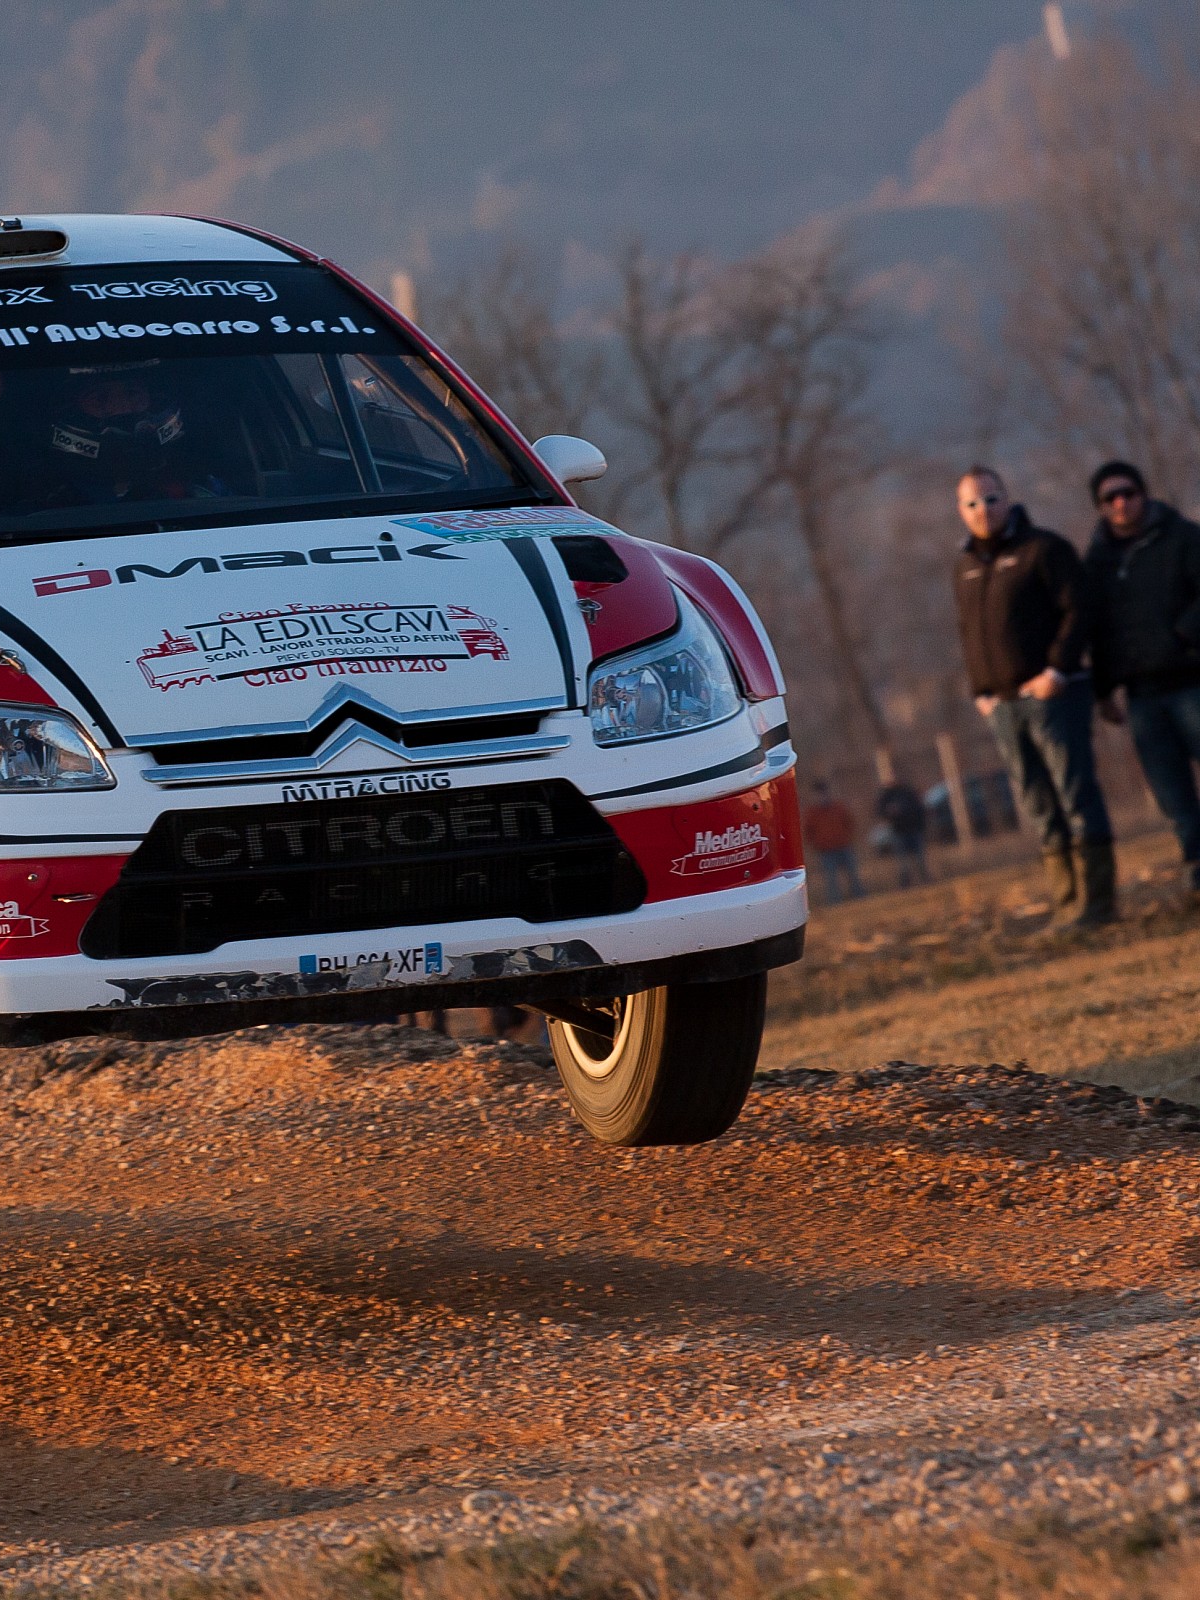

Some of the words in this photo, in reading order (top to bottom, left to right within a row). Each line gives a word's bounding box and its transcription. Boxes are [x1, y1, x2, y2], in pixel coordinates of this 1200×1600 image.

[69, 277, 280, 302] racing
[273, 315, 377, 335] S.r.l.
[218, 607, 282, 623] Ciao
[285, 602, 390, 615] Franco
[195, 626, 246, 652] LA
[254, 610, 450, 644] EDILSCAVI
[204, 649, 250, 663] SCAVI
[260, 639, 313, 655] LAVORI
[315, 634, 388, 648] STRADALI
[392, 634, 411, 644] ED
[413, 633, 462, 644] AFFINI
[276, 651, 309, 664] PIEVE
[312, 648, 326, 659] DI
[329, 645, 375, 656] SOLIGO
[695, 822, 762, 854] Mediatica
[698, 846, 757, 870] communication
